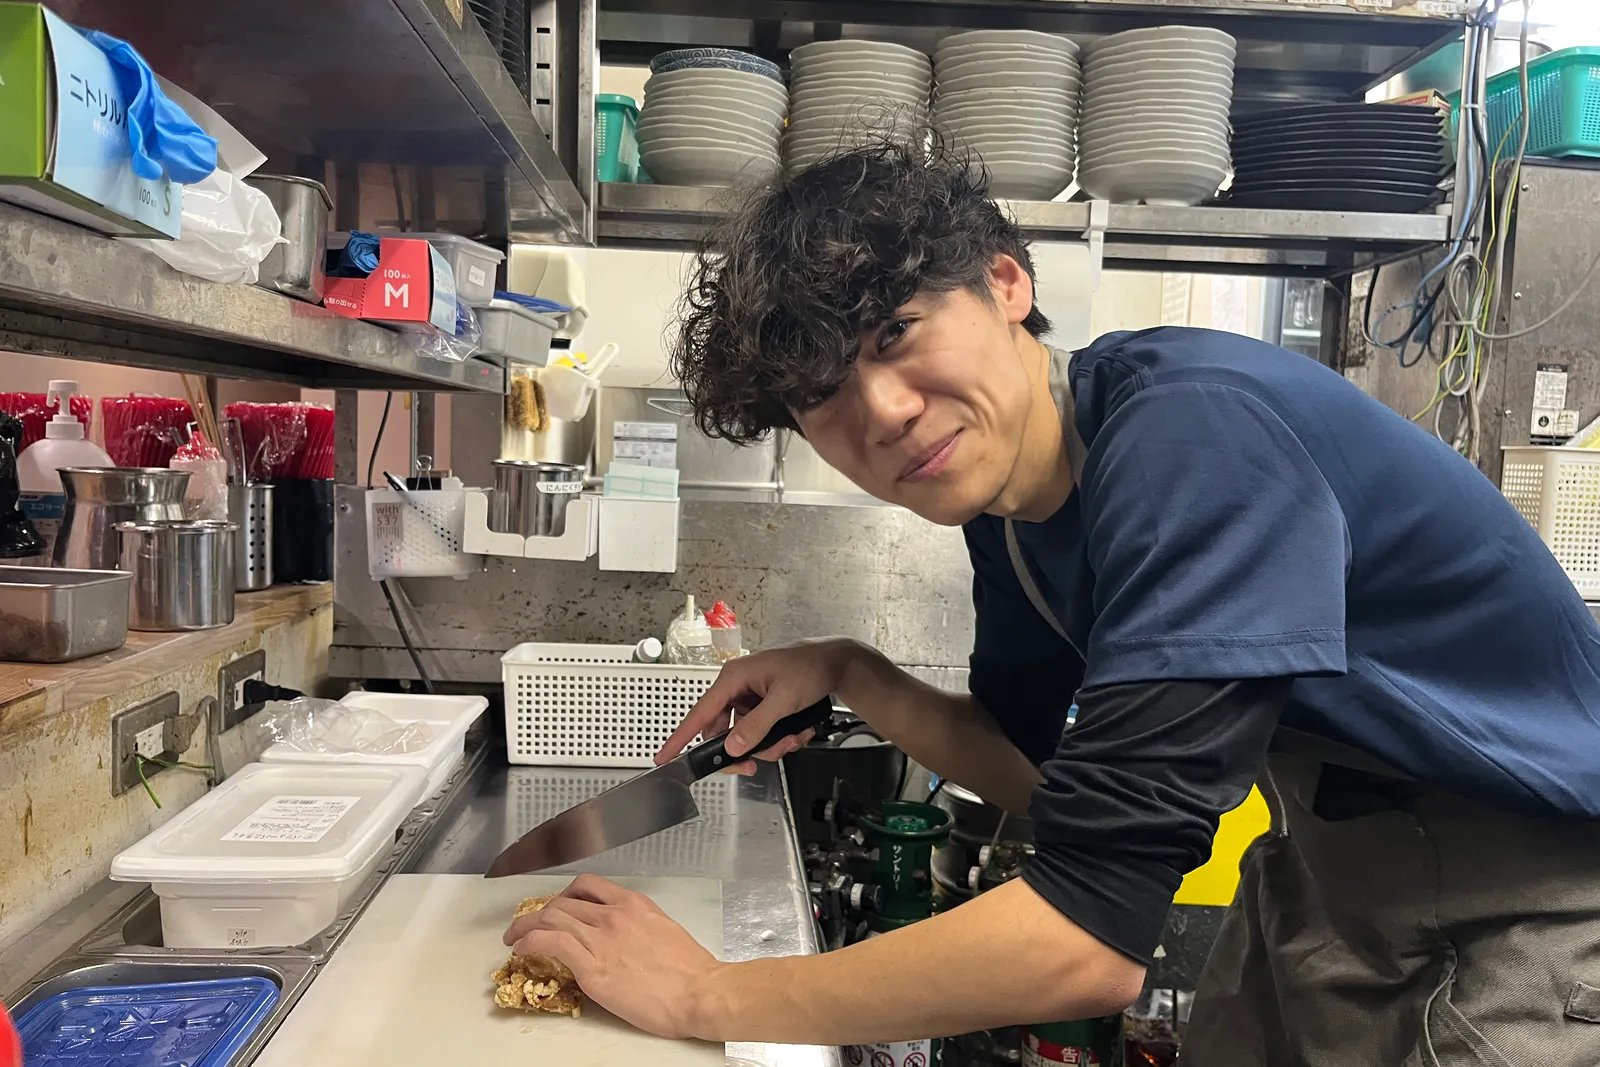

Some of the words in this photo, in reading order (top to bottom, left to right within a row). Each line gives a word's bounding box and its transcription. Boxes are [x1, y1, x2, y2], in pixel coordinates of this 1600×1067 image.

[69, 73, 128, 130] ニトリル
[163, 185, 172, 217] S
[384, 282, 409, 309] M
[375, 504, 399, 514] with
[892, 844, 903, 891] サントリー
